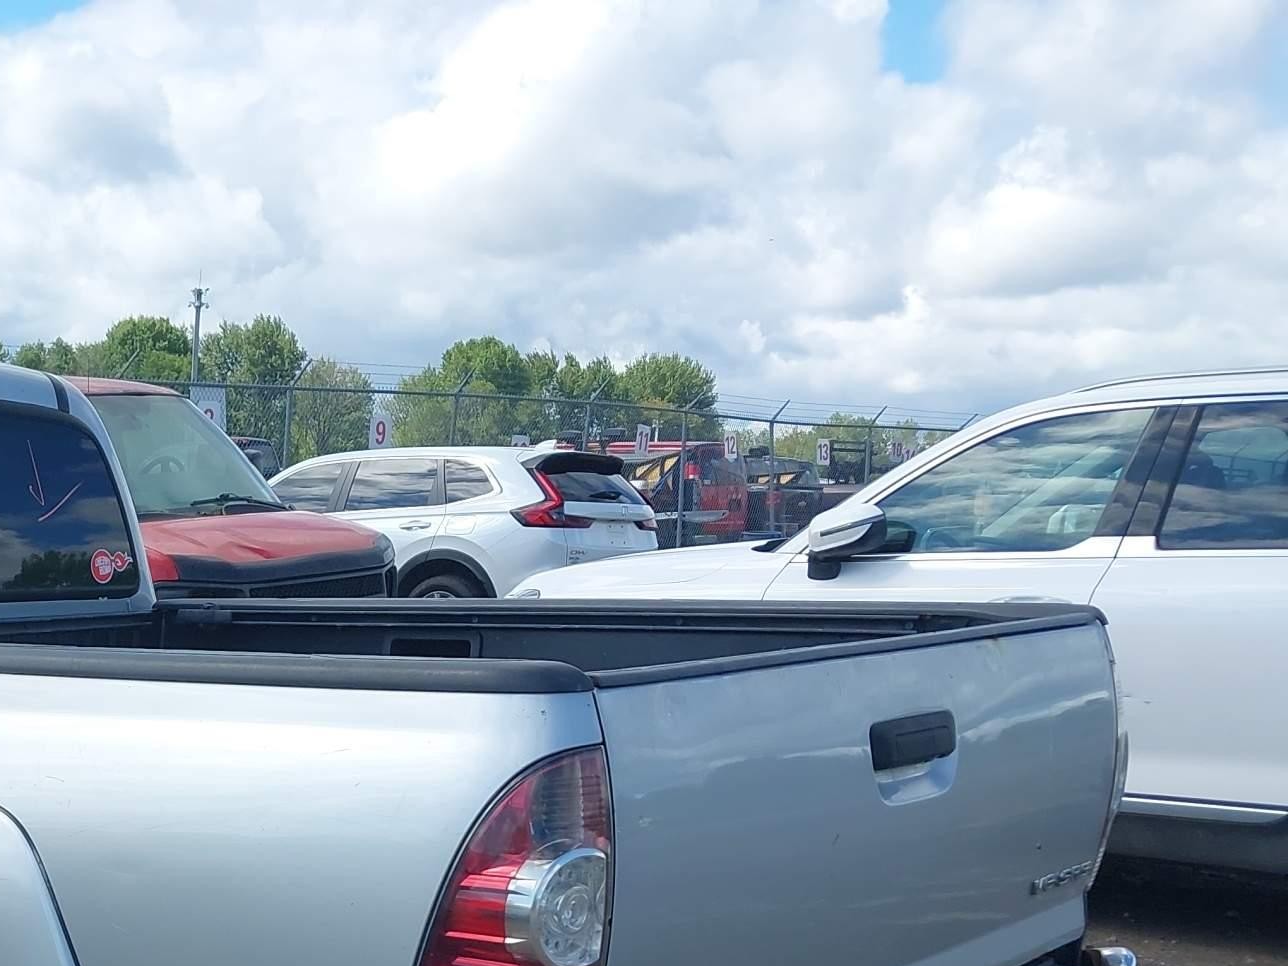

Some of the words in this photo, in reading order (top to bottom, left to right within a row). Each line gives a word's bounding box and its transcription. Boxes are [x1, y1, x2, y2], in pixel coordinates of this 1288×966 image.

[375, 420, 386, 445] 9
[638, 431, 649, 451] 11
[725, 436, 736, 454] 12
[817, 443, 829, 461] 13
